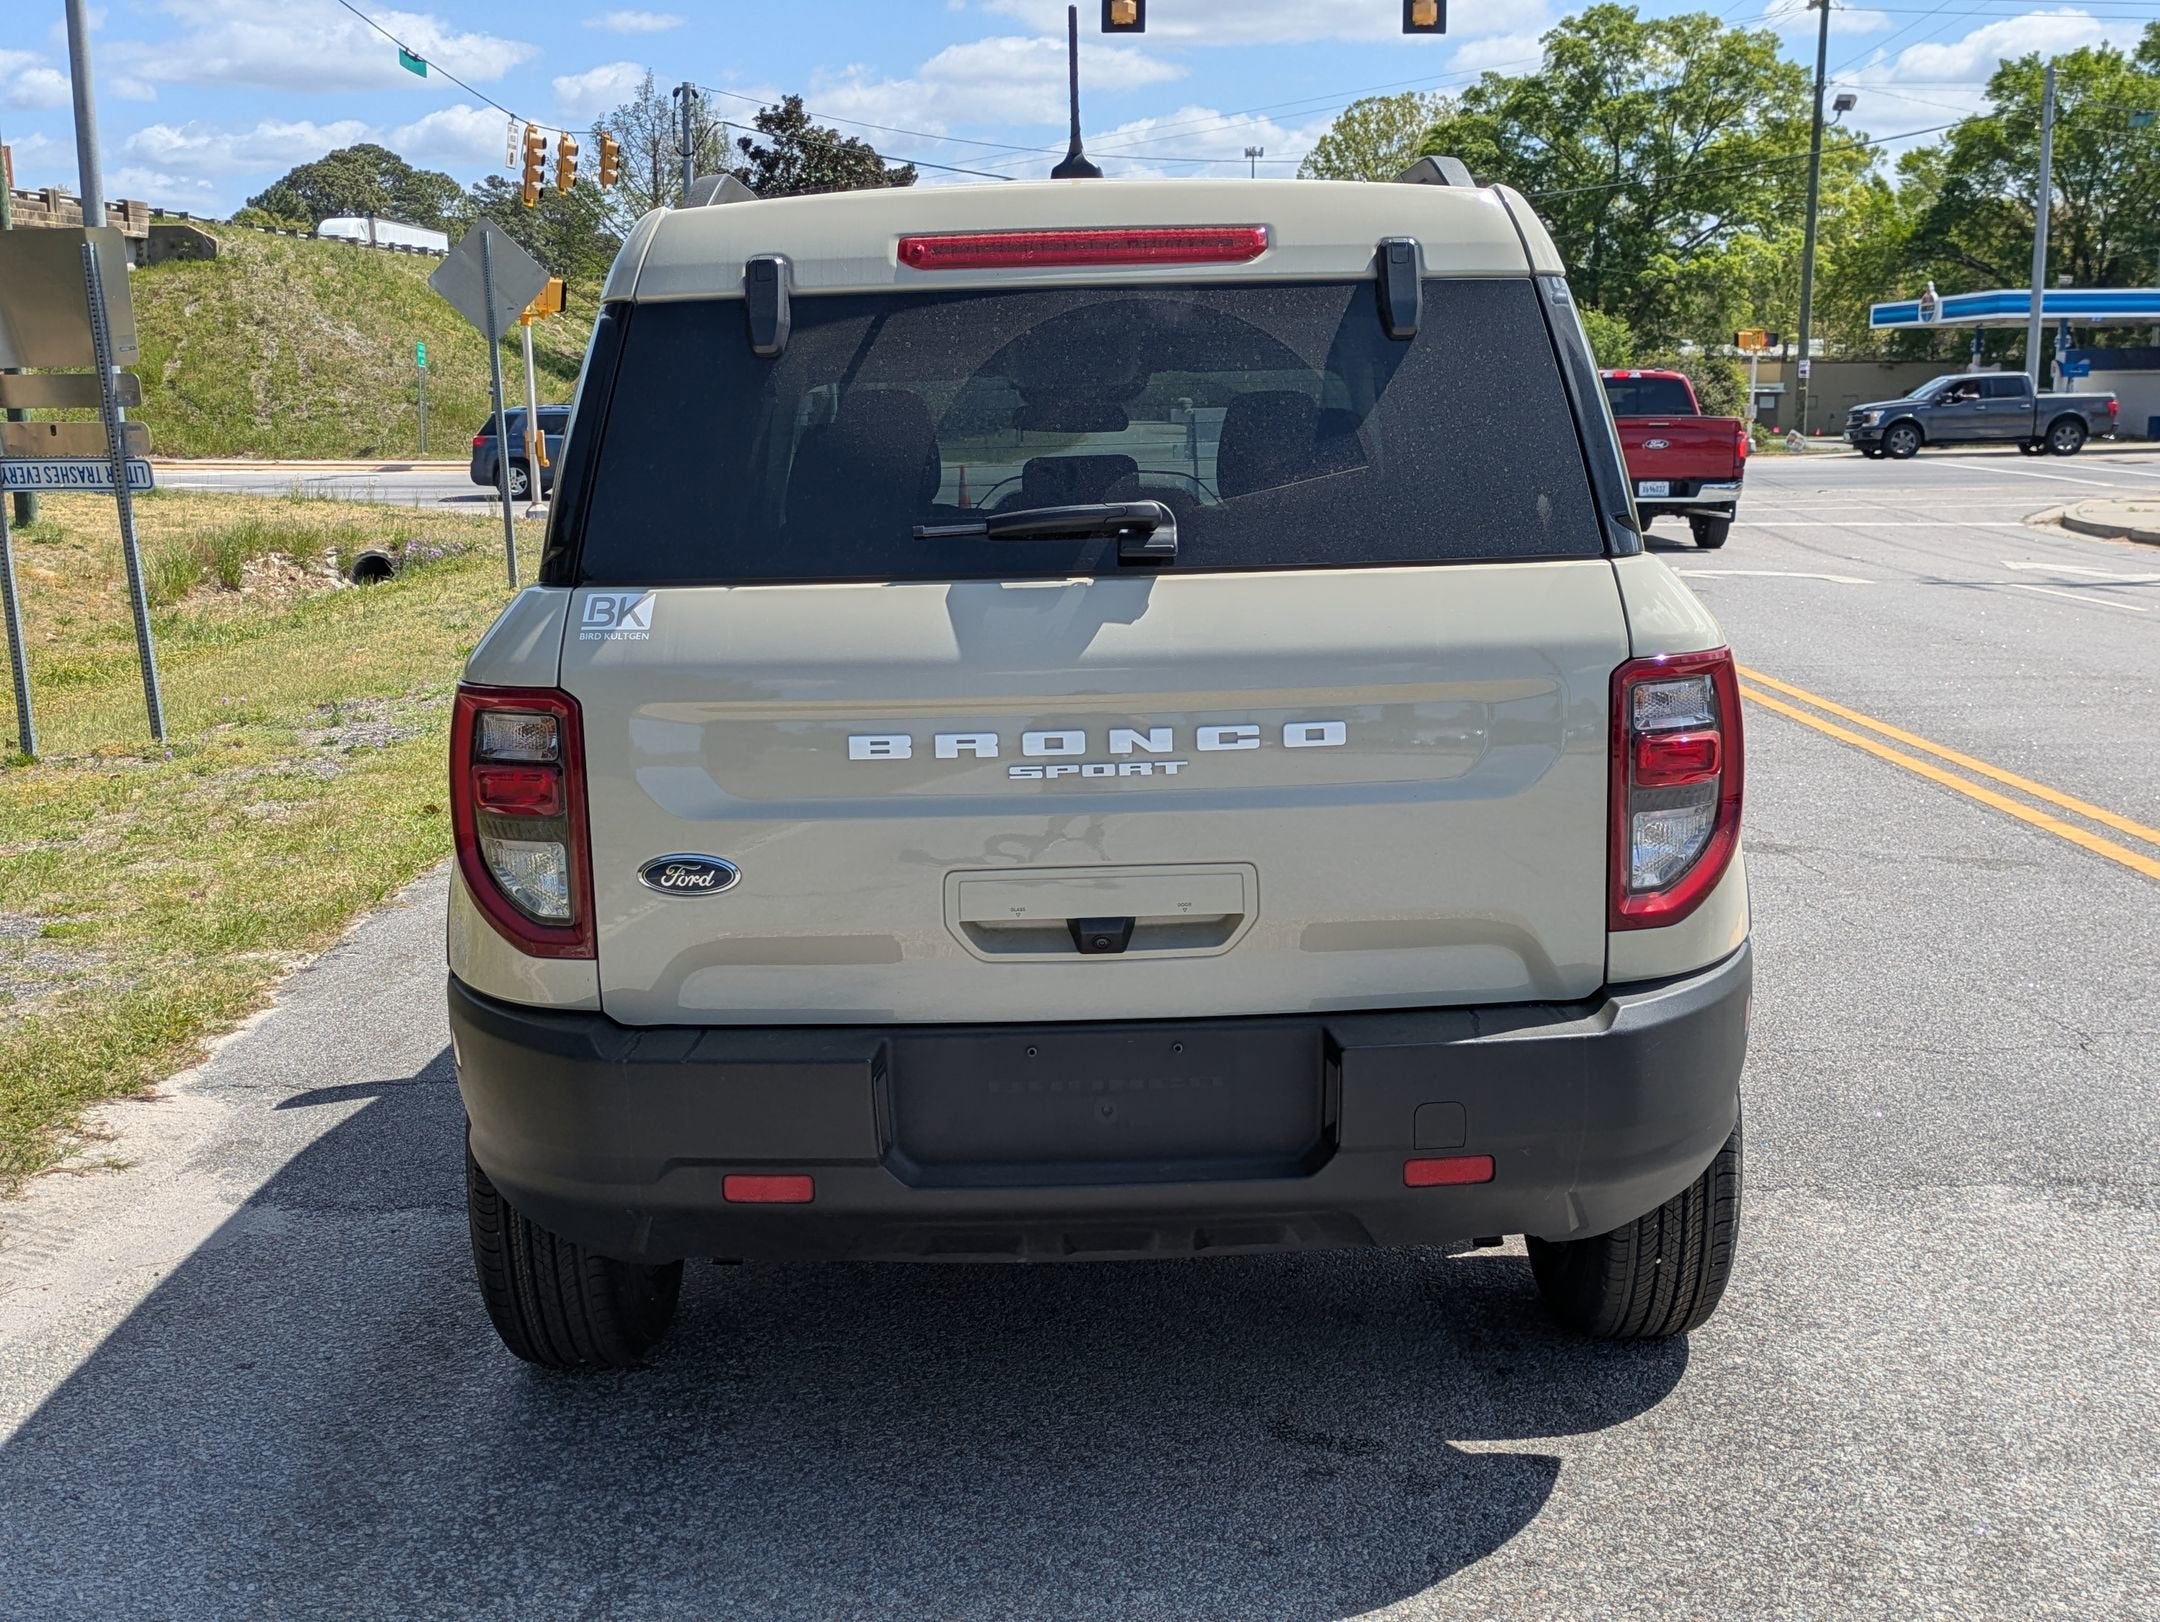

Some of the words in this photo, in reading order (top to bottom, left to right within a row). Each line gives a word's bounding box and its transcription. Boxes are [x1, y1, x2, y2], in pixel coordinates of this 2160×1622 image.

[1, 466, 41, 484] EVERY
[45, 466, 103, 484] TRASHES
[106, 466, 147, 484] LITR
[582, 594, 655, 629] BK
[579, 632, 602, 641] BIRD
[604, 632, 650, 641] KULTGEN
[847, 720, 1347, 761] BRONCO
[1008, 760, 1188, 780] SPORT
[660, 864, 716, 887] Ford
